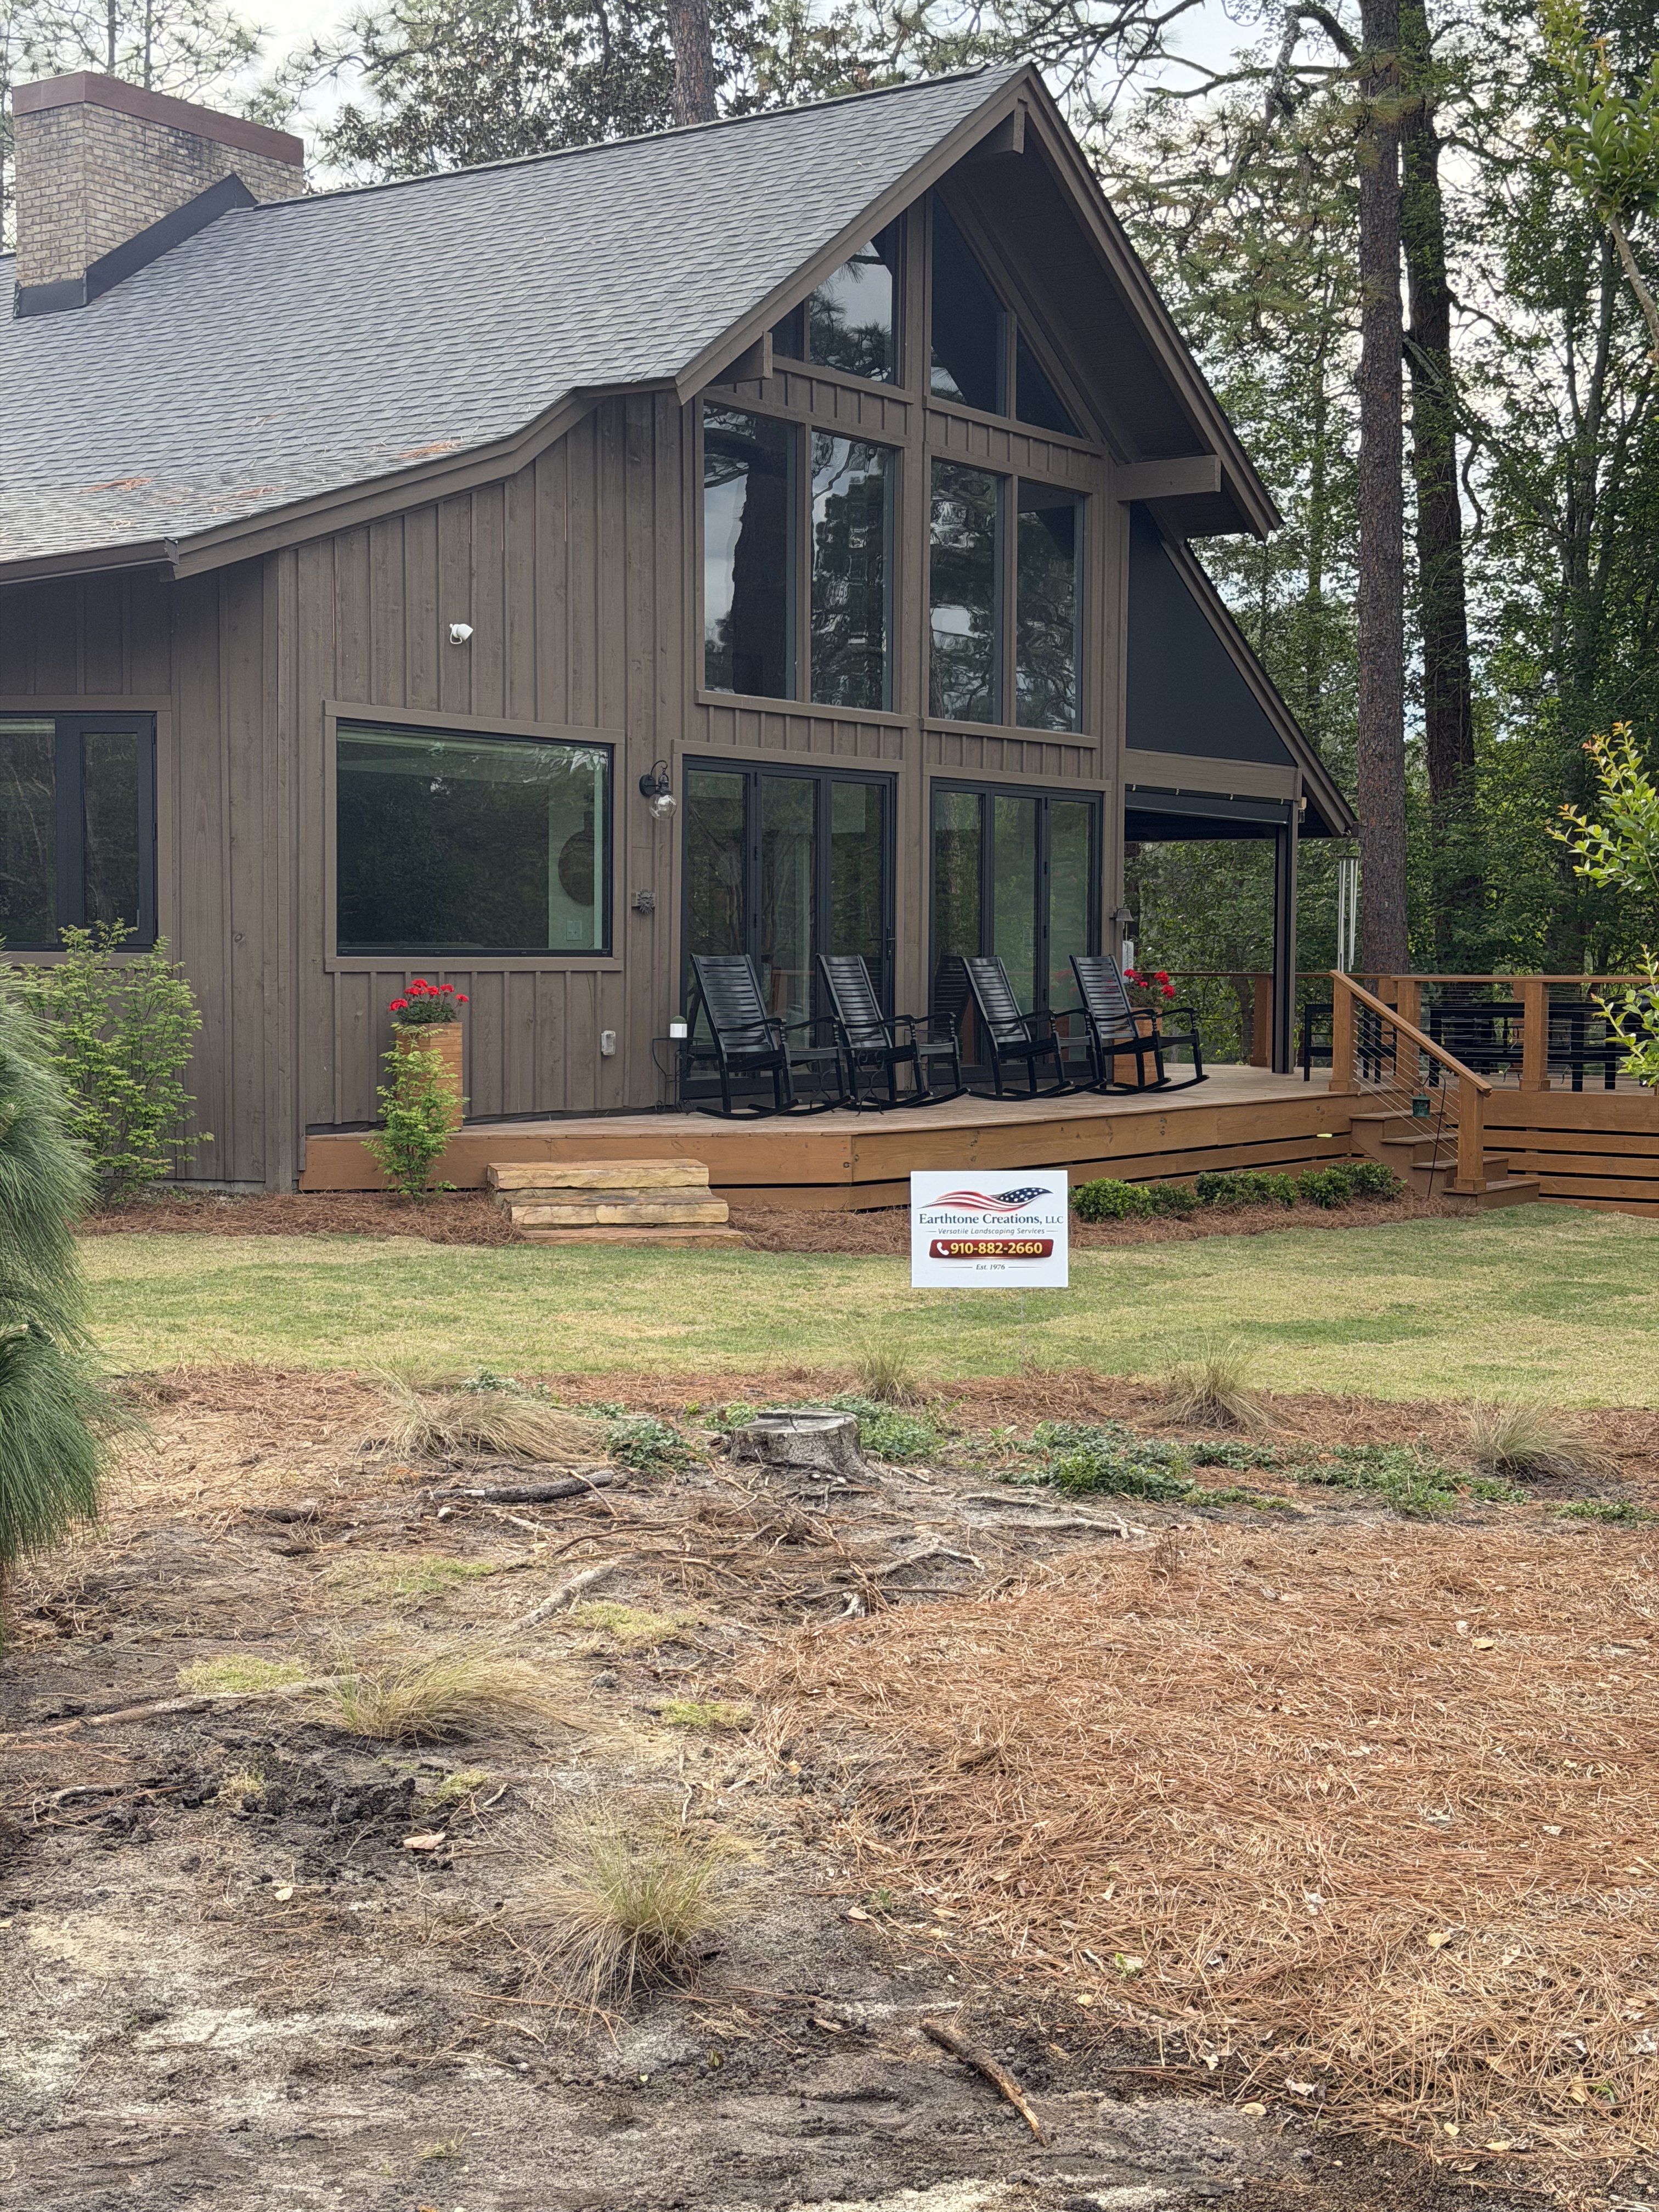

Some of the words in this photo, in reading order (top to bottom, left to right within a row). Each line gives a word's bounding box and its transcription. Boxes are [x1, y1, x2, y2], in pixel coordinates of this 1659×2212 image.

[919, 1213, 979, 1224] Earthtone
[983, 1213, 1042, 1225] Creations,
[1045, 1216, 1064, 1224] LLC
[950, 1242, 1043, 1254] 910-882-2660
